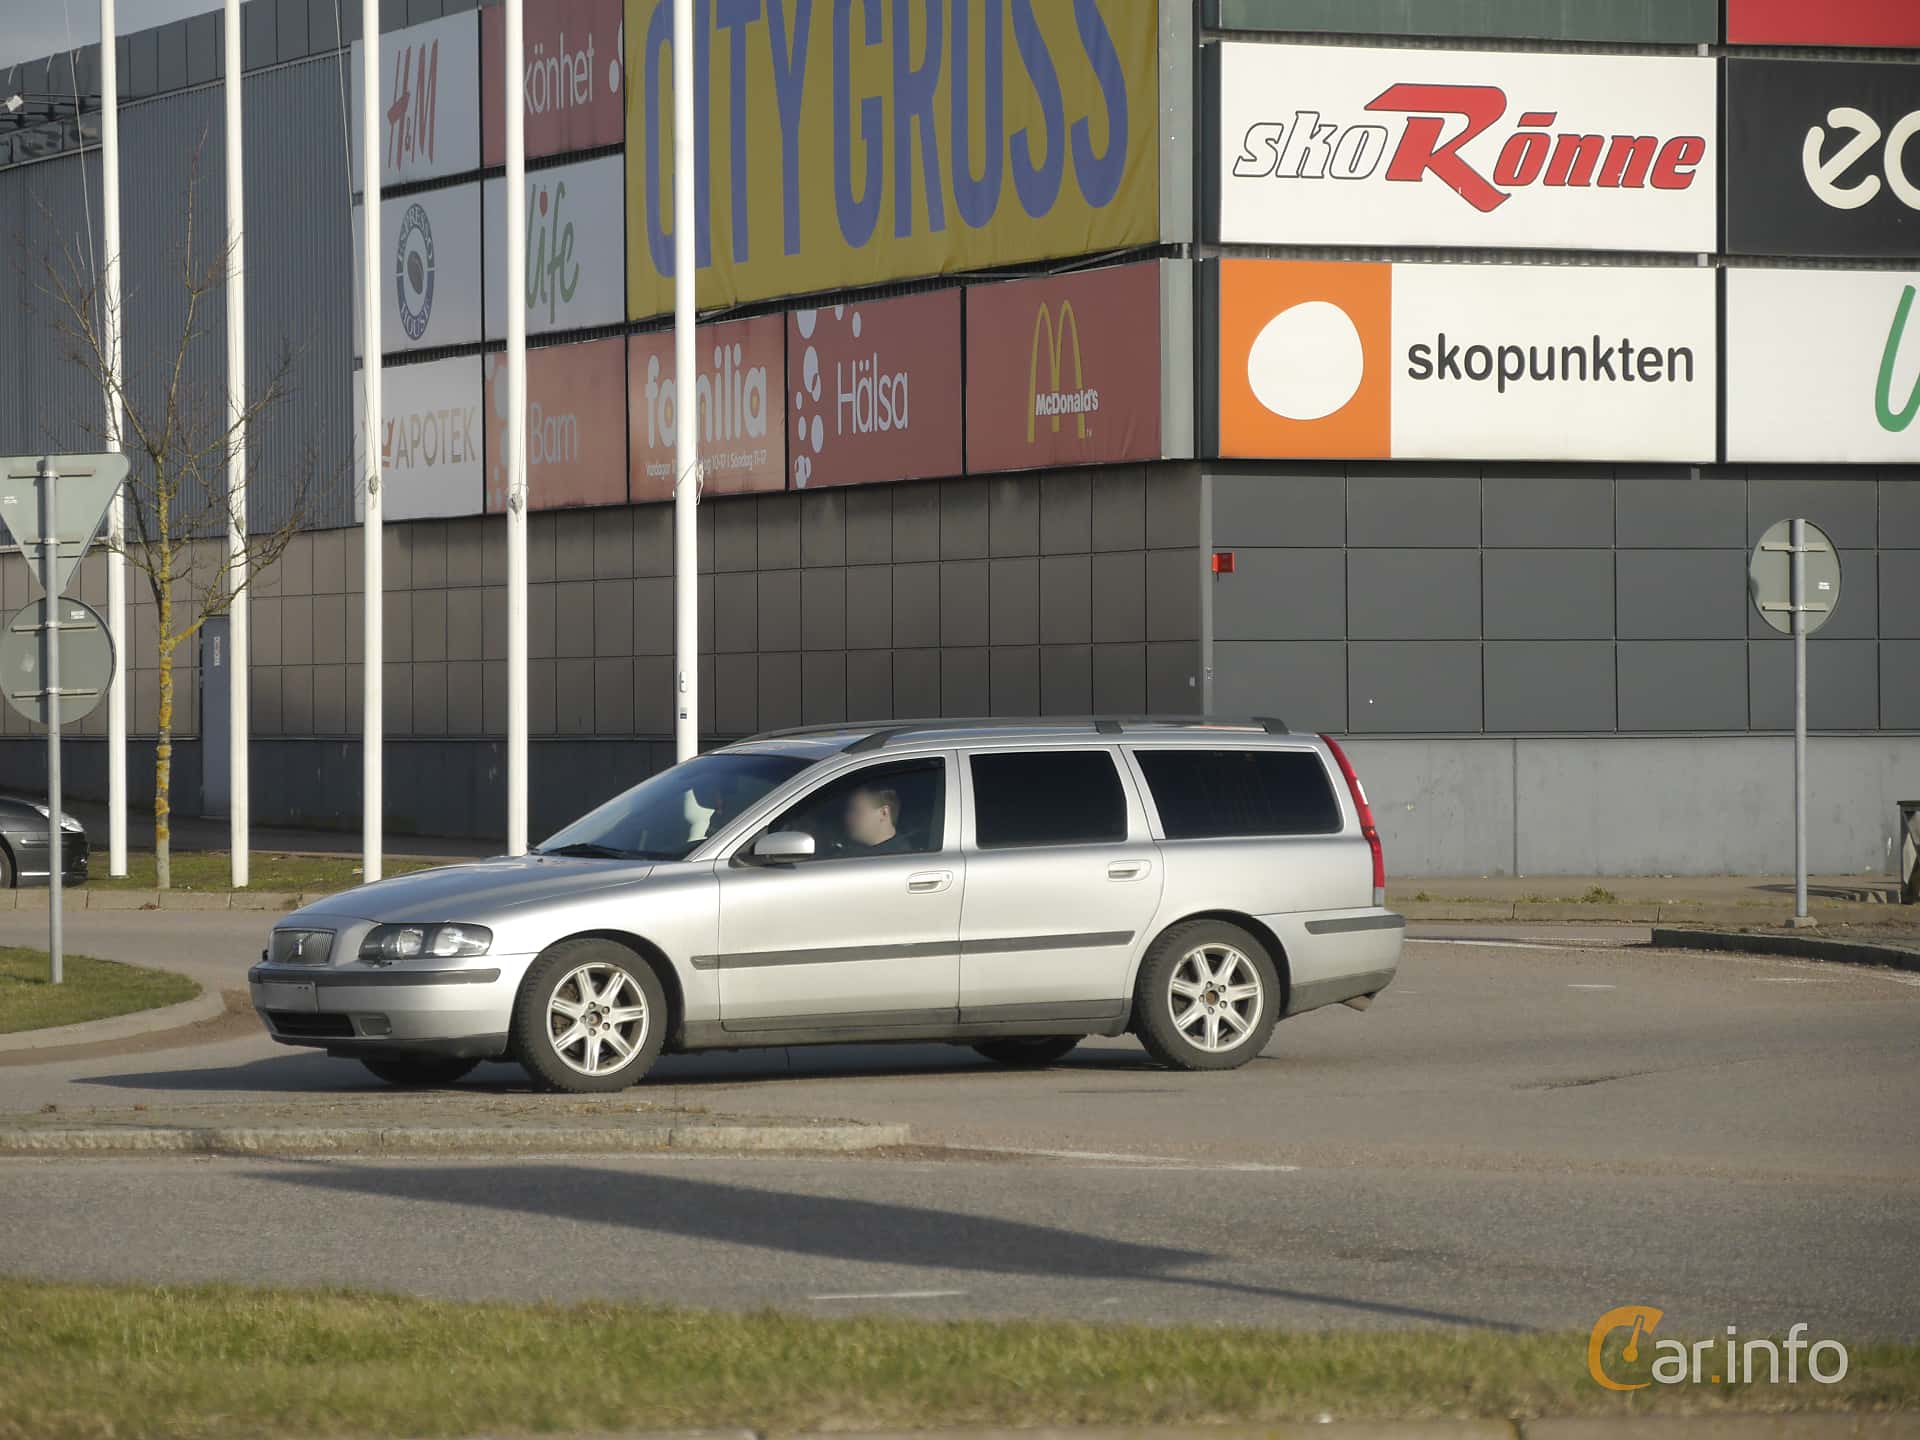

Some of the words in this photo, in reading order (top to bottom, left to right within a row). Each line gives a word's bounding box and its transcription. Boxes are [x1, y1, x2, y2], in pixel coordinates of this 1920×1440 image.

[387, 38, 438, 172] H&M
[523, 32, 594, 115] könhet
[526, 181, 580, 324] life
[836, 352, 909, 435] Hälsa
[1035, 388, 1099, 416] McDonald's
[1407, 332, 1695, 394] skopunkten
[395, 406, 479, 470] APOTEK
